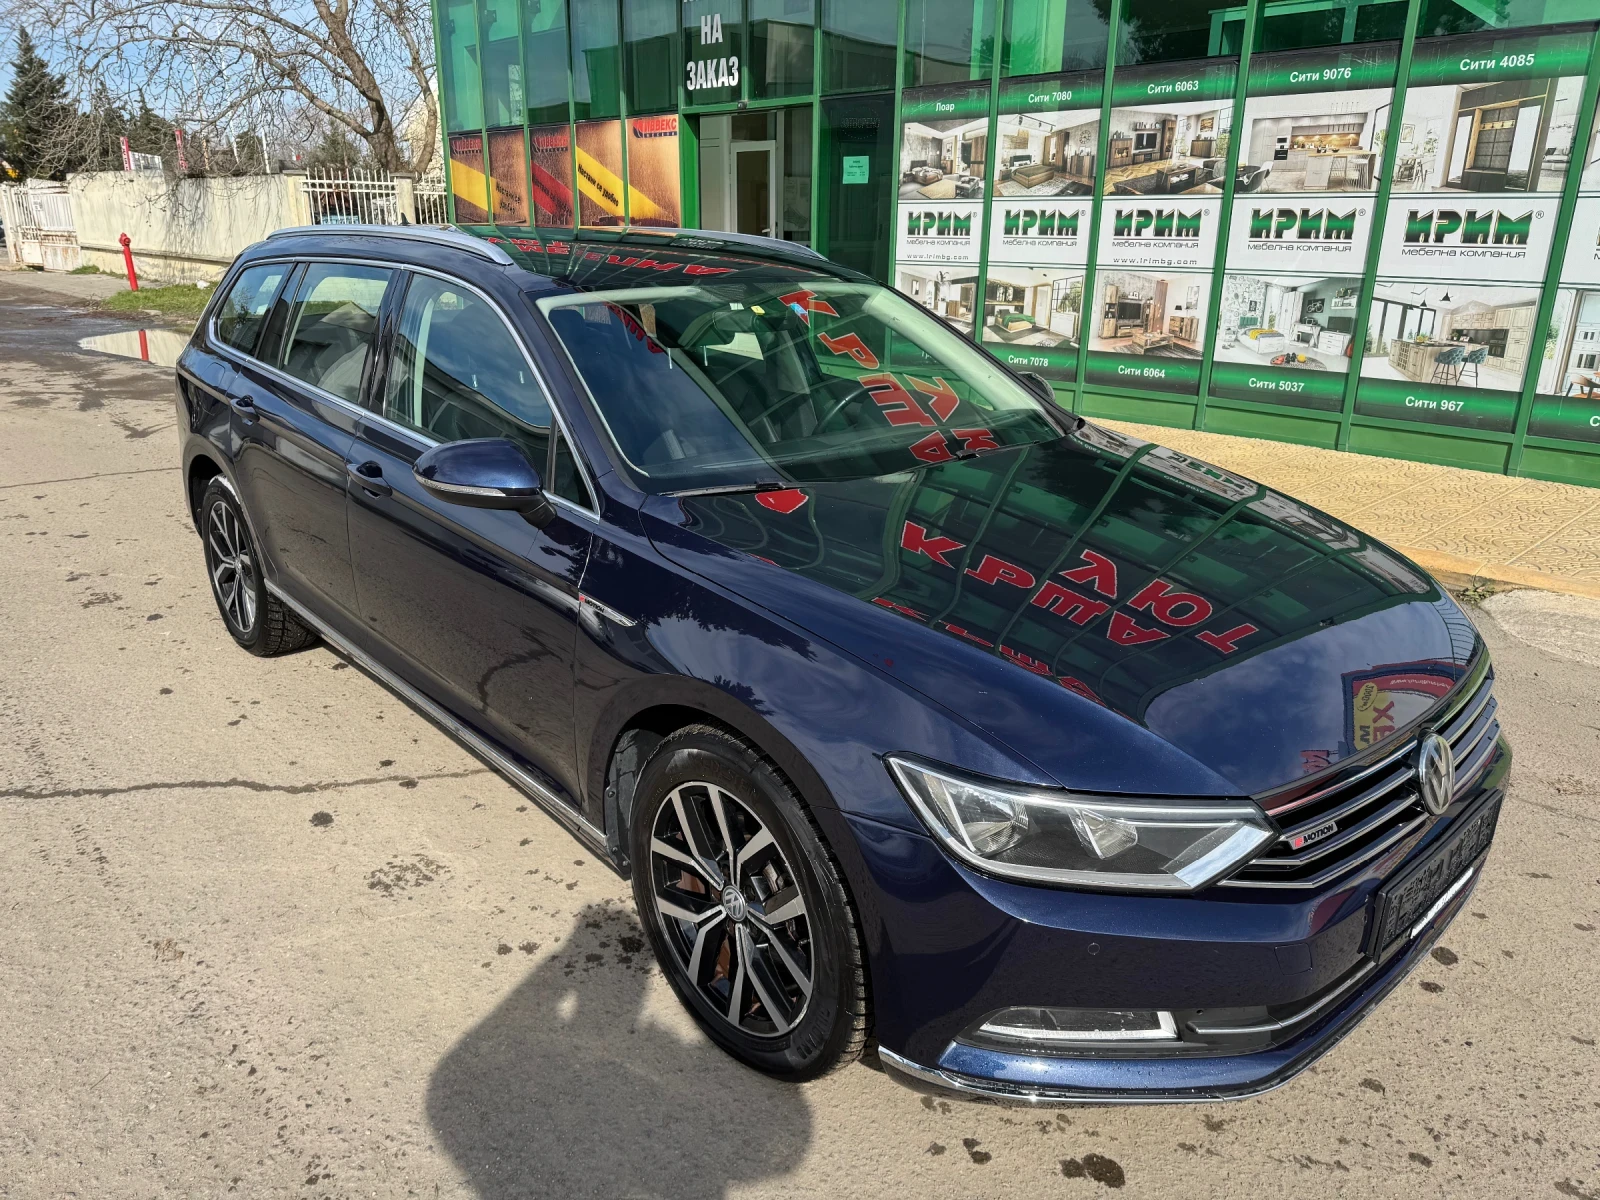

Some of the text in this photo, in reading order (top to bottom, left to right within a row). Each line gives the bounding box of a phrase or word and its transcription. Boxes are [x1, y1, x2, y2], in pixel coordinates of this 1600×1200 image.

[700, 13, 723, 45] НА
[1459, 53, 1535, 71] Сити 4085
[686, 55, 739, 91] ЗАКАЗ
[1289, 67, 1352, 83] Сити 9076
[1147, 80, 1199, 95] Сити 6063
[1028, 90, 1072, 104] Сити 7080
[935, 103, 955, 112] Лоар
[907, 211, 972, 236] ИРИМ
[1003, 209, 1080, 236] ИРИМ
[1113, 208, 1202, 237] ИРИМ
[1248, 208, 1357, 240] ИРИМ
[1403, 209, 1534, 245] ИРИМ
[1112, 240, 1151, 248] мебелна
[1247, 243, 1352, 252] мебелна компания
[1113, 257, 1198, 266] www.irimbg.com
[1401, 248, 1526, 259] мебелна компания
[1008, 354, 1049, 367] Сити 7078
[1118, 365, 1166, 378] Сити 6064
[1248, 377, 1305, 393] Сити 5037
[1405, 396, 1464, 412] Сити 967
